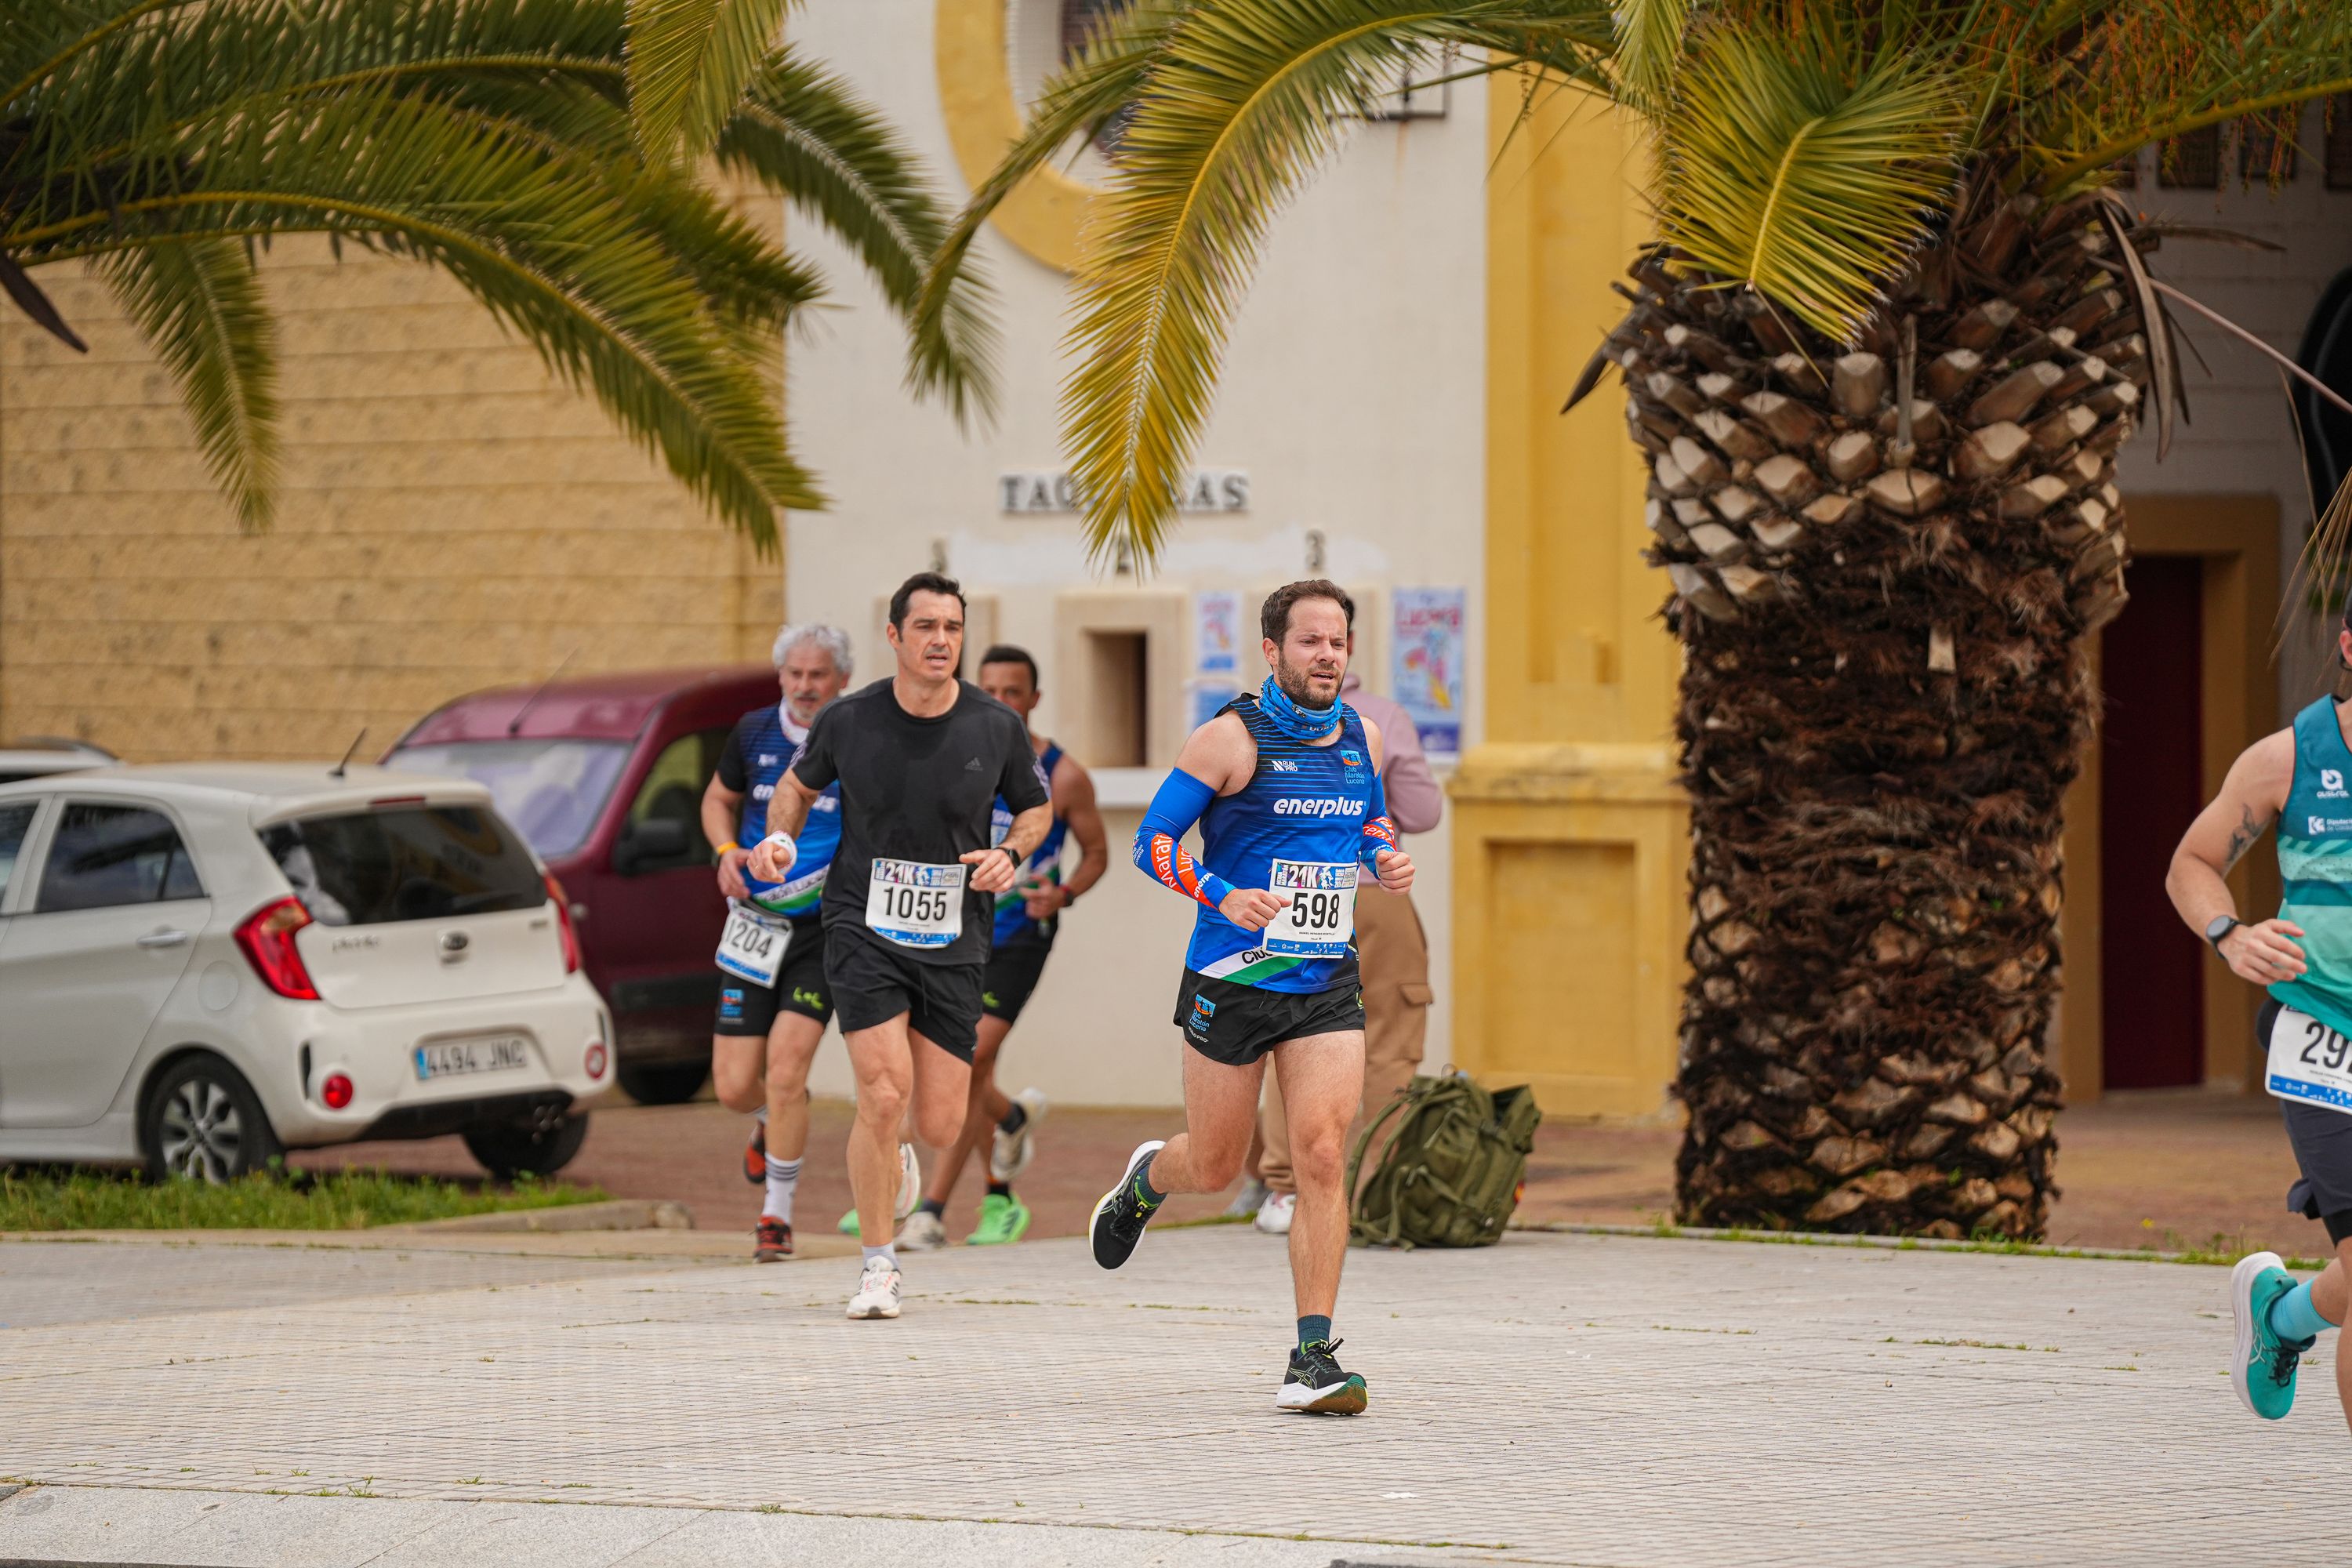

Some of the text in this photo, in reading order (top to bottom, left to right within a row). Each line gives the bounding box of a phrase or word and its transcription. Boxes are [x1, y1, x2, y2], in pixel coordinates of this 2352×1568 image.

[1305, 528, 1326, 572] 3
[1273, 796, 1363, 818] enerplus
[884, 862, 916, 885] 21K
[1288, 865, 1319, 888] 21K
[884, 886, 947, 921] 1055
[1291, 892, 1340, 929] 598
[425, 1040, 525, 1073] 4494 JNC
[2300, 1021, 2352, 1074] 29
